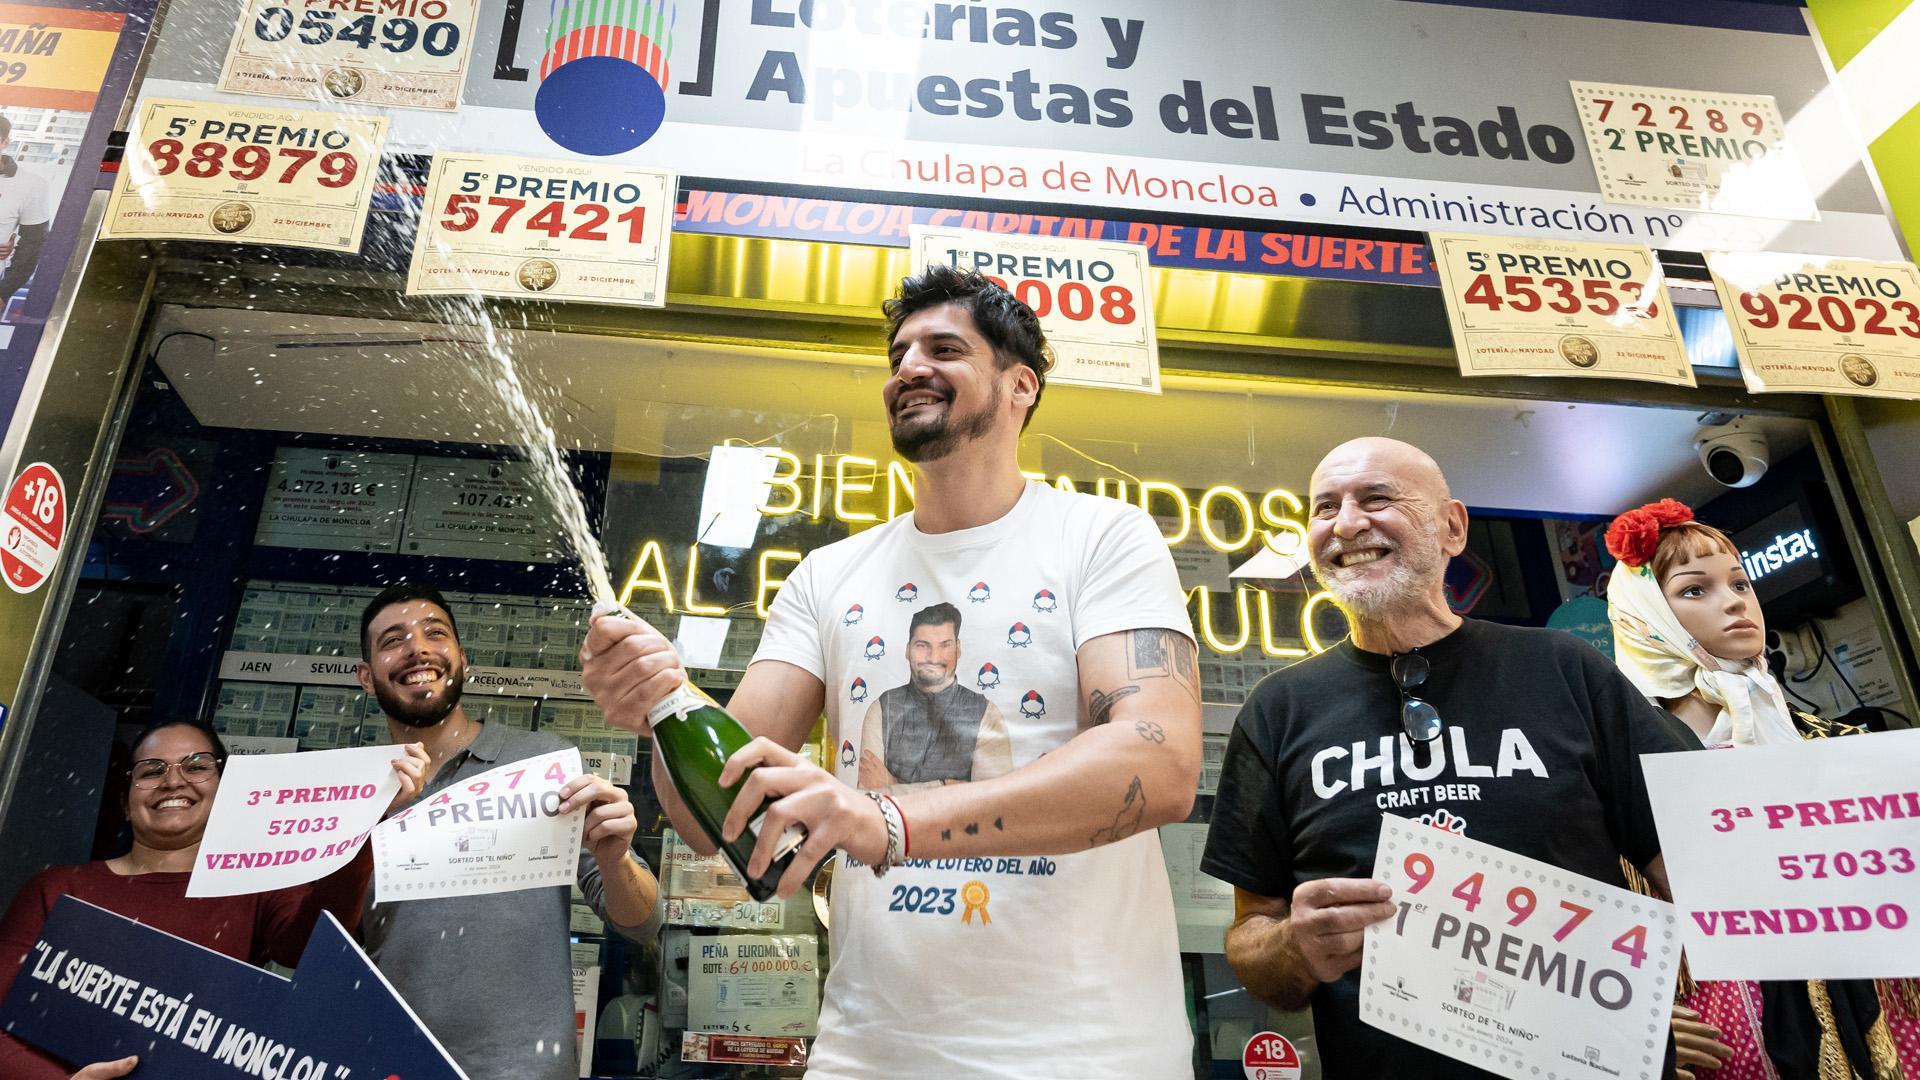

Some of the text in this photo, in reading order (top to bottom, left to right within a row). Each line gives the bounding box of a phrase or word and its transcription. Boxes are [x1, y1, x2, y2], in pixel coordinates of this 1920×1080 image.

[0, 22, 62, 56] AÑA
[254, 7, 460, 57] 05490
[1100, 16, 1145, 70] y
[745, 49, 1576, 165] Apuestas del Estado
[200, 120, 350, 150] PREMIO
[1635, 130, 1768, 160] PREMIO
[149, 139, 358, 188] 88979
[518, 164, 563, 174] VENDIDO
[494, 174, 641, 204] PREMIO
[801, 143, 845, 175] La
[859, 148, 1028, 193] Chulapa
[1042, 161, 1091, 192] de
[1106, 166, 1278, 208] Moncloa
[1338, 185, 1635, 235] Administración
[440, 194, 646, 244] 57421
[685, 190, 914, 238] MONCLOA
[1127, 221, 1183, 258] DE
[1194, 227, 1247, 262] LA
[1260, 231, 1425, 275] SUERTE
[590, 277, 636, 285] DICIEMBRE
[973, 250, 1115, 283] PREMIO
[1497, 253, 1632, 280] PREMIO
[985, 275, 1136, 325] 008
[1774, 273, 1901, 299] PREMIO
[1739, 291, 1920, 339] 92023
[1088, 359, 1131, 369] DICIEMBRE
[24, 477, 59, 524] +18
[757, 449, 1308, 556] BIENDOS
[617, 541, 726, 615] AL
[240, 661, 357, 674] JAEN SEVILLA
[464, 674, 519, 686] ARCELONA
[1311, 725, 1549, 800] CHULA
[275, 783, 377, 805] PREMIO
[428, 790, 561, 827] PREMIO
[1376, 784, 1481, 809] CRAFT BEER
[1763, 792, 1920, 829] PREMI
[267, 816, 339, 836] 57033
[205, 847, 318, 870] VENDIDO
[449, 857, 474, 865] SORTEO
[996, 859, 1024, 875] DEL
[1027, 857, 1057, 876] AÑO
[1778, 847, 1916, 881] 57033
[889, 884, 957, 915] 2023
[1691, 903, 1909, 937] VENDIDO
[702, 942, 800, 958] PEÑA EUROMILON
[1431, 913, 1633, 1011] PREMIO
[58, 957, 141, 1016] SUERTE
[130, 986, 194, 1040] ESTÁ
[181, 1008, 223, 1054] EN
[1441, 1002, 1475, 1020] SORTEO
[1477, 1015, 1490, 1026] DE
[1253, 1039, 1286, 1060] +18
